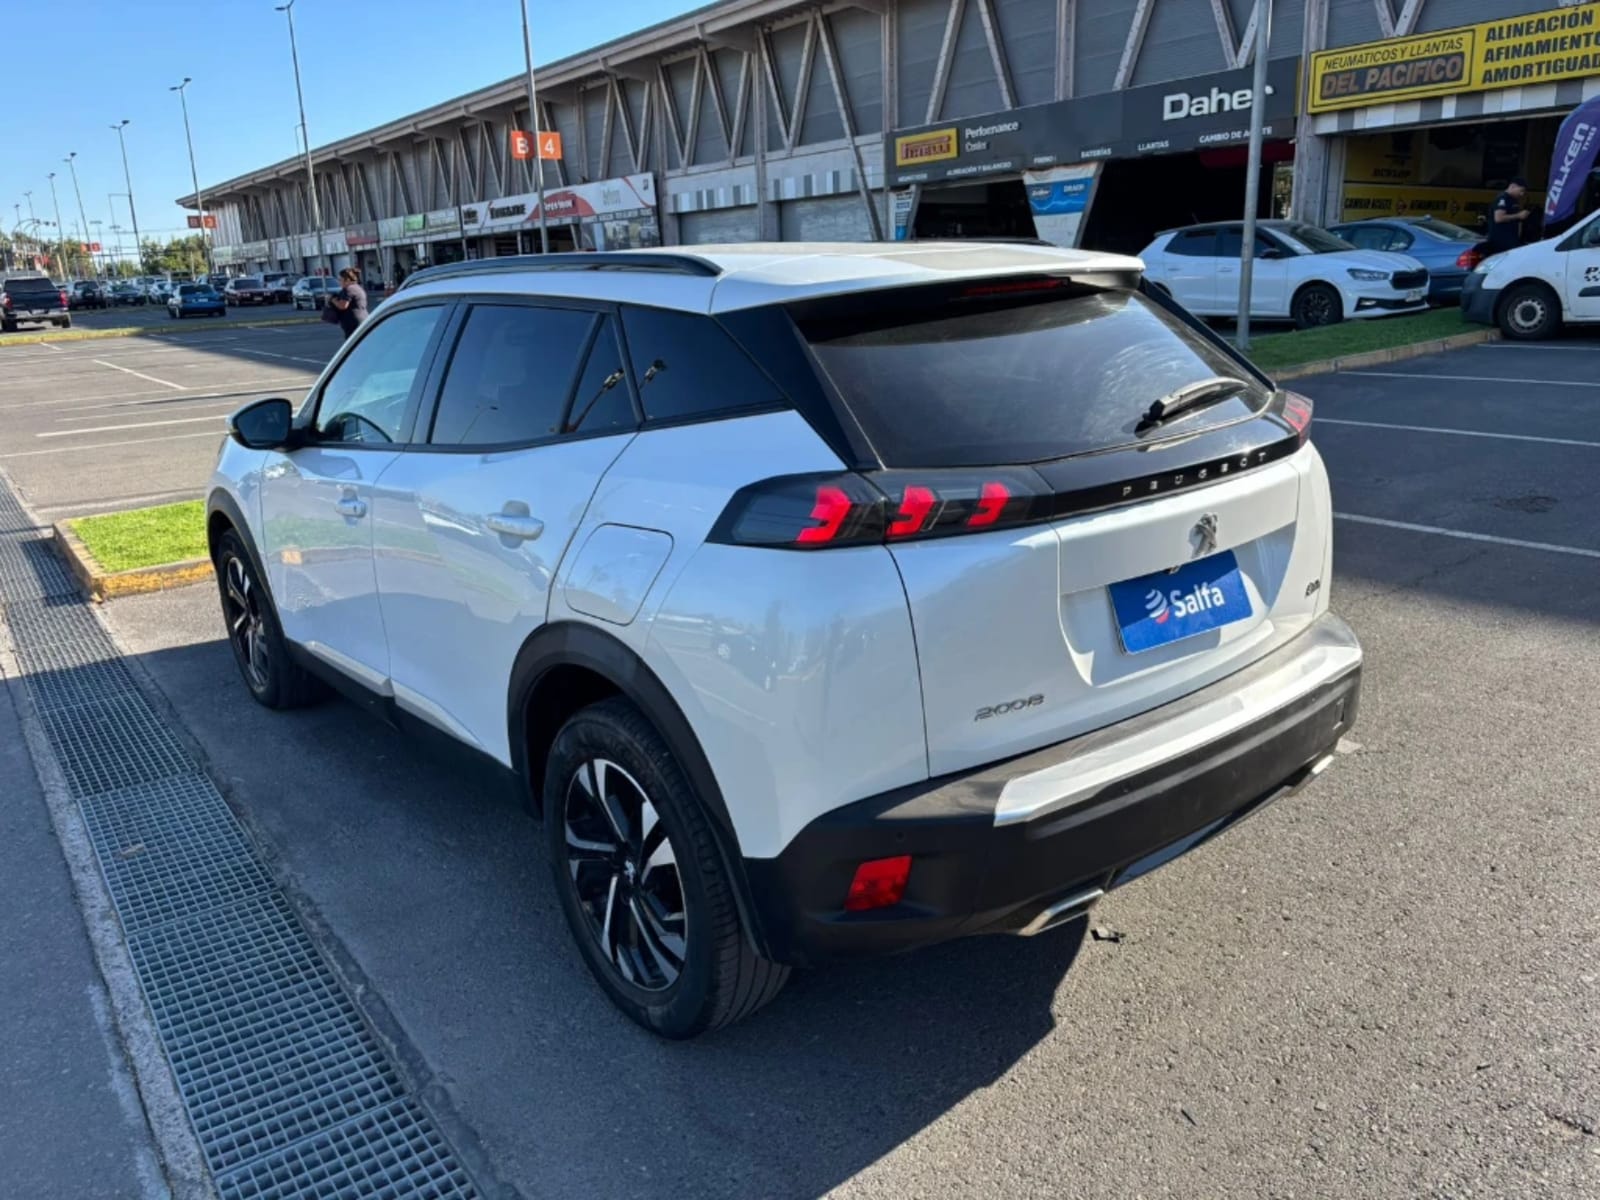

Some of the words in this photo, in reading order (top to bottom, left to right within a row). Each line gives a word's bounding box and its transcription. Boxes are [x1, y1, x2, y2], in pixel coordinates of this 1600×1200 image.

[1485, 7, 1594, 43] ALINEACIÓN
[1322, 49, 1398, 71] NEUMATICOS
[1400, 46, 1408, 58] Y
[1410, 37, 1464, 57] LLANTAS
[1482, 52, 1600, 84] AMORTIGUAD
[1321, 71, 1360, 97] DEL
[1364, 55, 1463, 91] PACIFICO
[516, 137, 529, 154] B
[544, 138, 555, 155] 4
[965, 121, 1019, 139] Performance
[900, 135, 951, 160] PIRELLI
[1122, 452, 1267, 497] PEUGEOT
[1170, 581, 1225, 618] Salfa
[974, 693, 1045, 722] 2008
